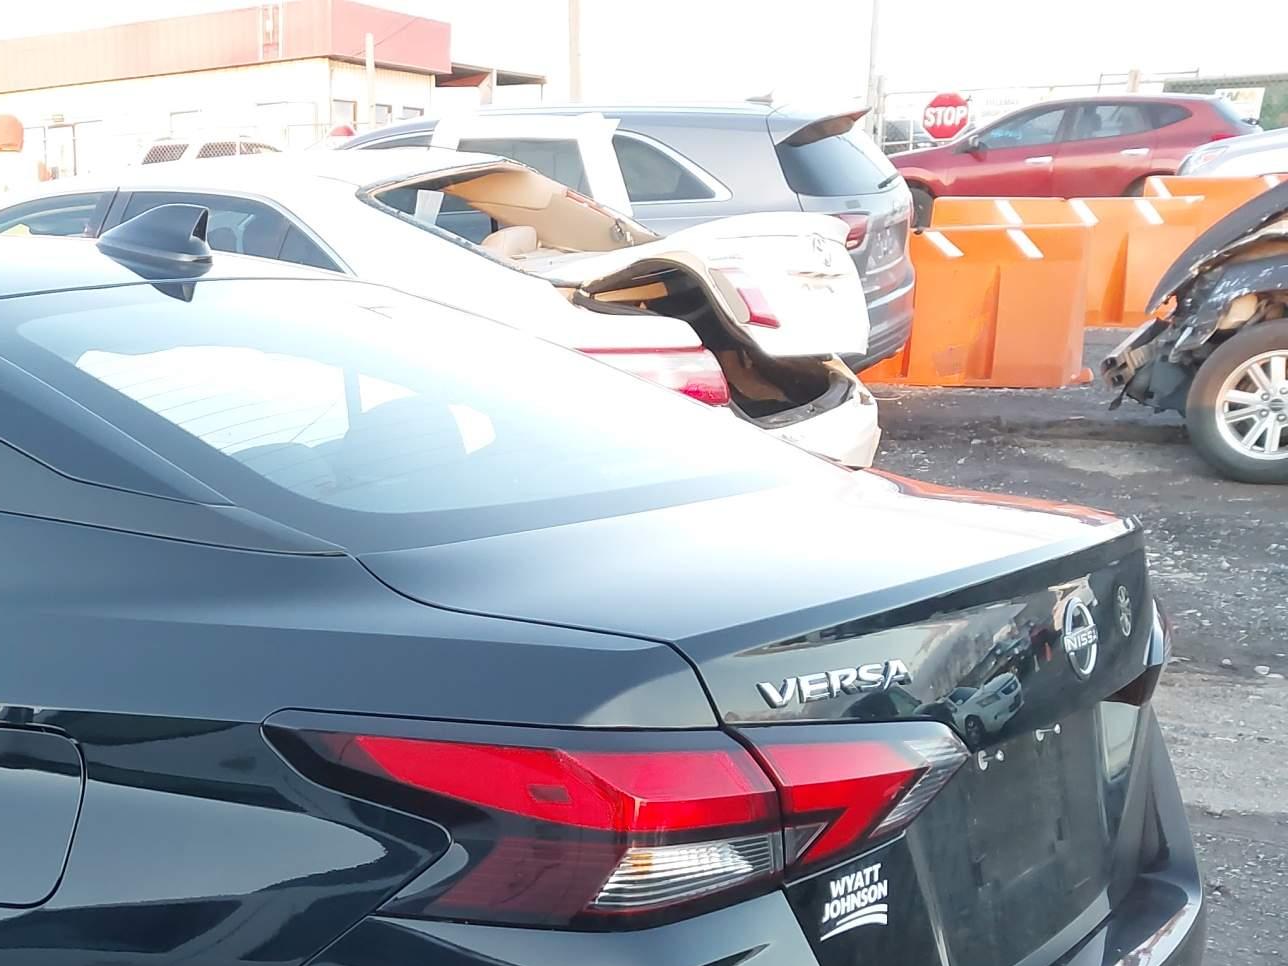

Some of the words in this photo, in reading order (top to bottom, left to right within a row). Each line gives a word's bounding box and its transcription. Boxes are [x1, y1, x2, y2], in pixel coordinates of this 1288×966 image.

[924, 106, 968, 128] STOP
[1064, 626, 1098, 652] NISS
[755, 658, 913, 709] VERSA
[830, 863, 882, 898] WYATT
[822, 880, 888, 924] JOHNSON
